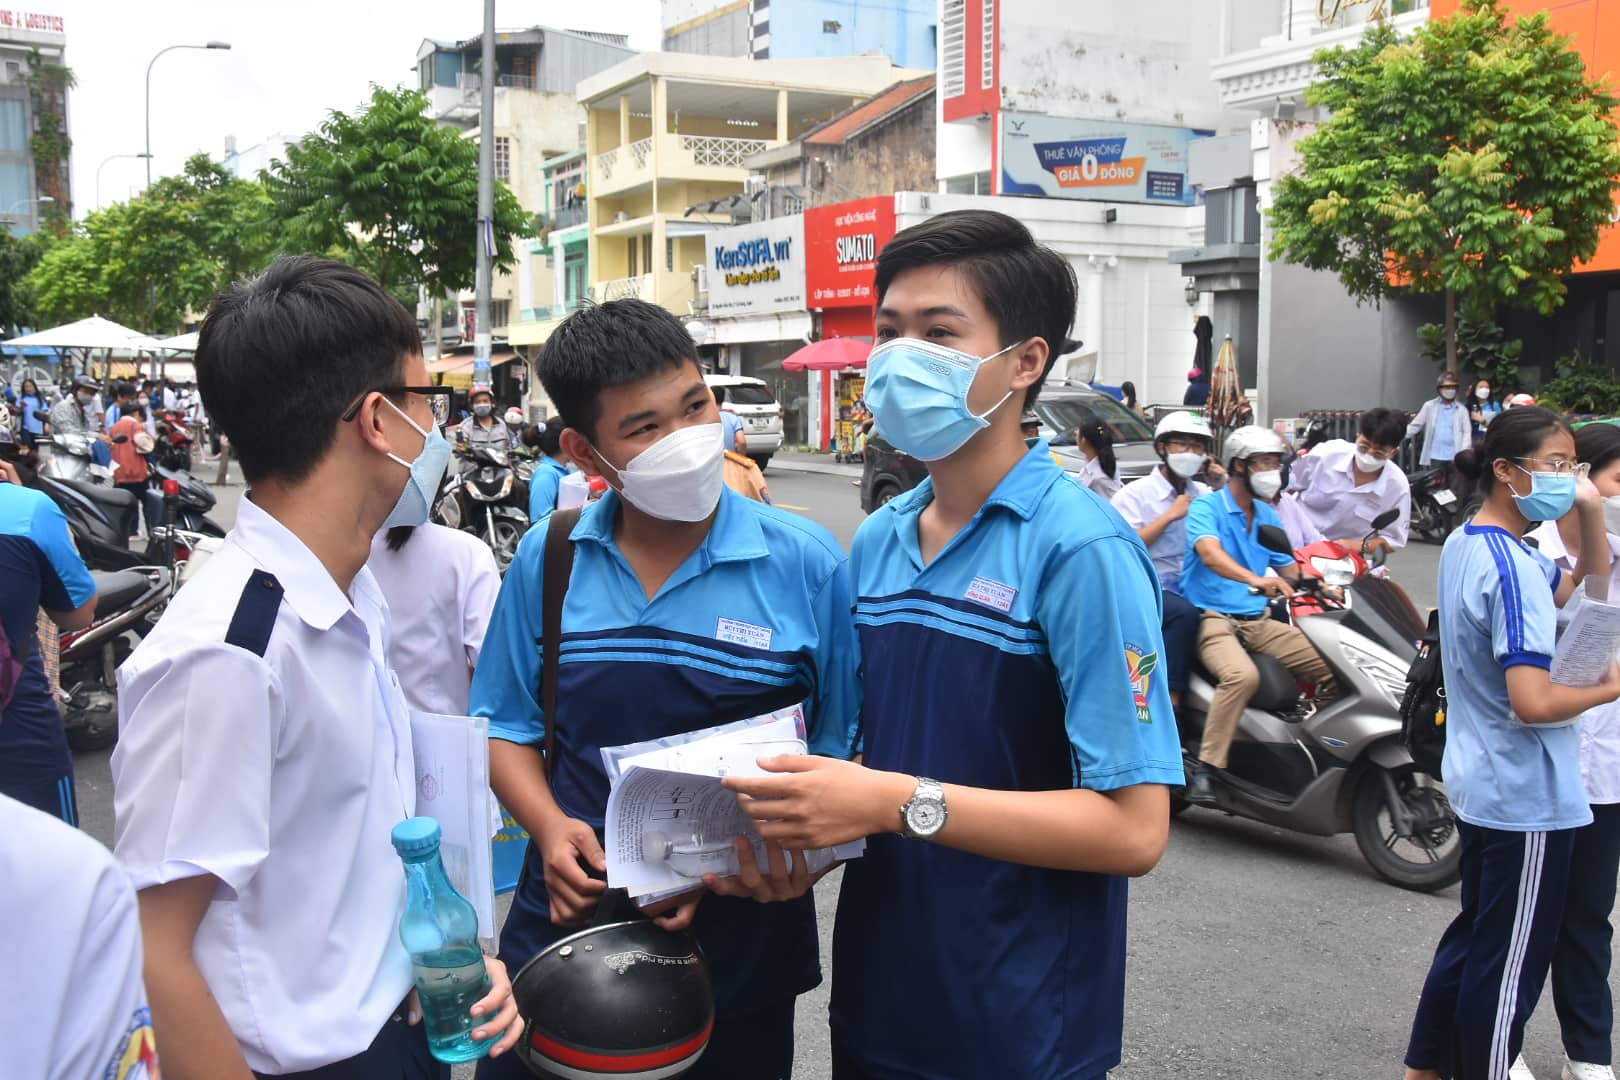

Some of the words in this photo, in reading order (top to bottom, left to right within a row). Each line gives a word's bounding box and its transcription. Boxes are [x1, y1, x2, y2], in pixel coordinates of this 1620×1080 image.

[24, 12, 64, 32] LOGISTICS
[1044, 147, 1065, 160] THUÊ
[1059, 166, 1081, 181] GIÁ
[1081, 154, 1098, 181] 0
[1100, 162, 1136, 180] ĐỒNG
[714, 237, 790, 270] KenSOFA.vn
